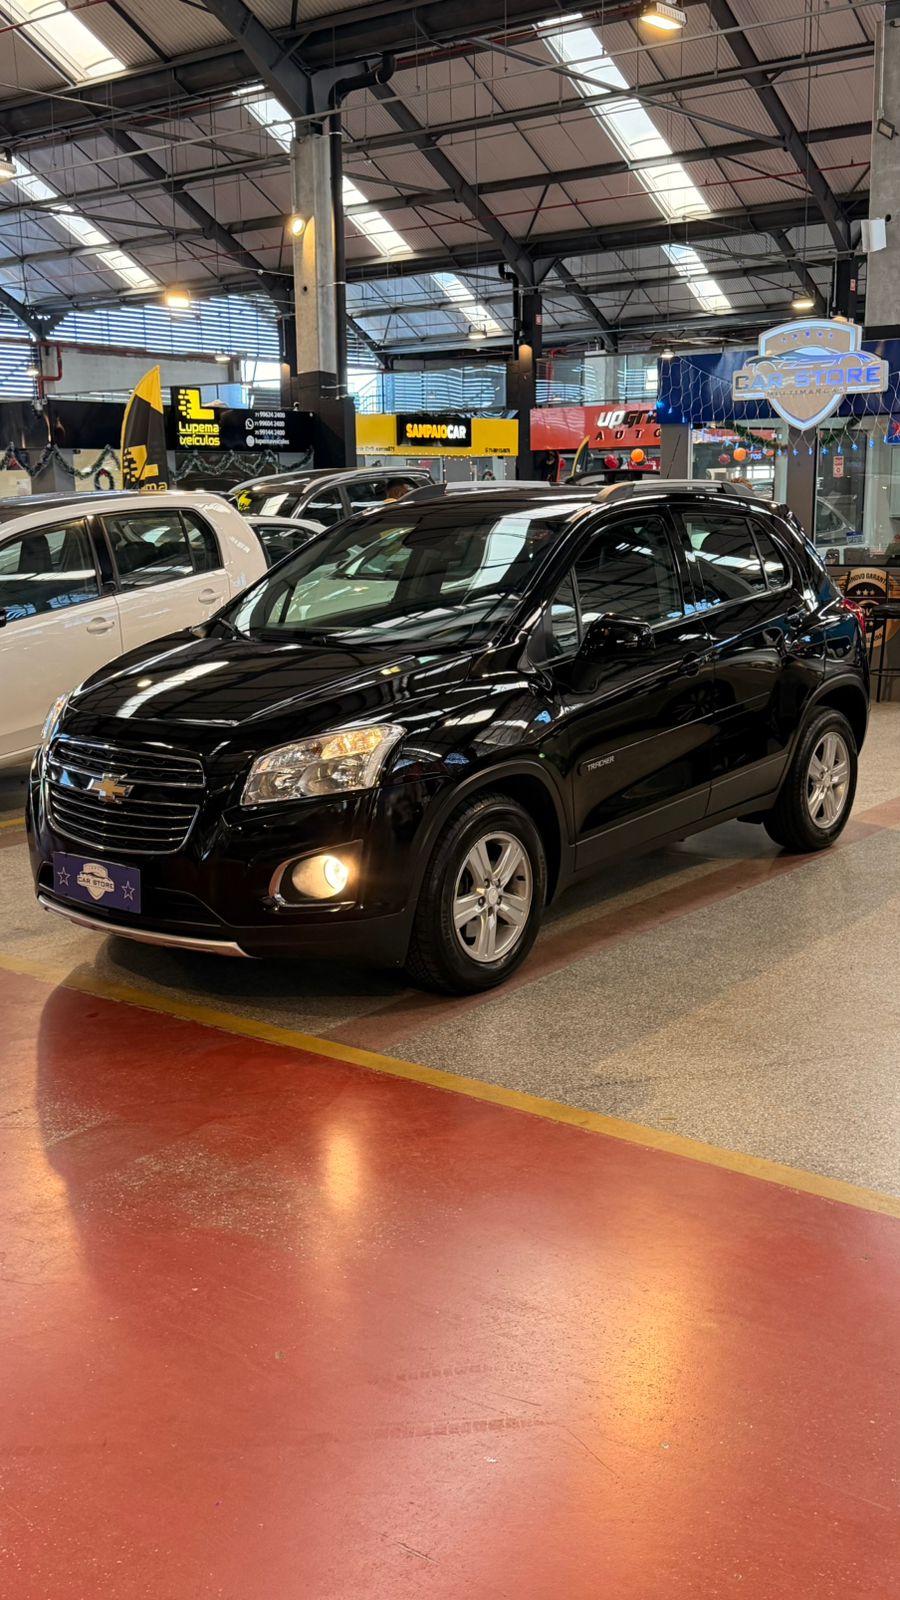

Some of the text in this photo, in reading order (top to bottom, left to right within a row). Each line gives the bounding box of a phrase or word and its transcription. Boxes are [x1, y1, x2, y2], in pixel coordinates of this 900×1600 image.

[735, 366, 881, 390] CAR STORE
[178, 421, 220, 434] Lupema
[587, 756, 615, 771] TRACKER
[78, 876, 114, 889] CAR STORE
